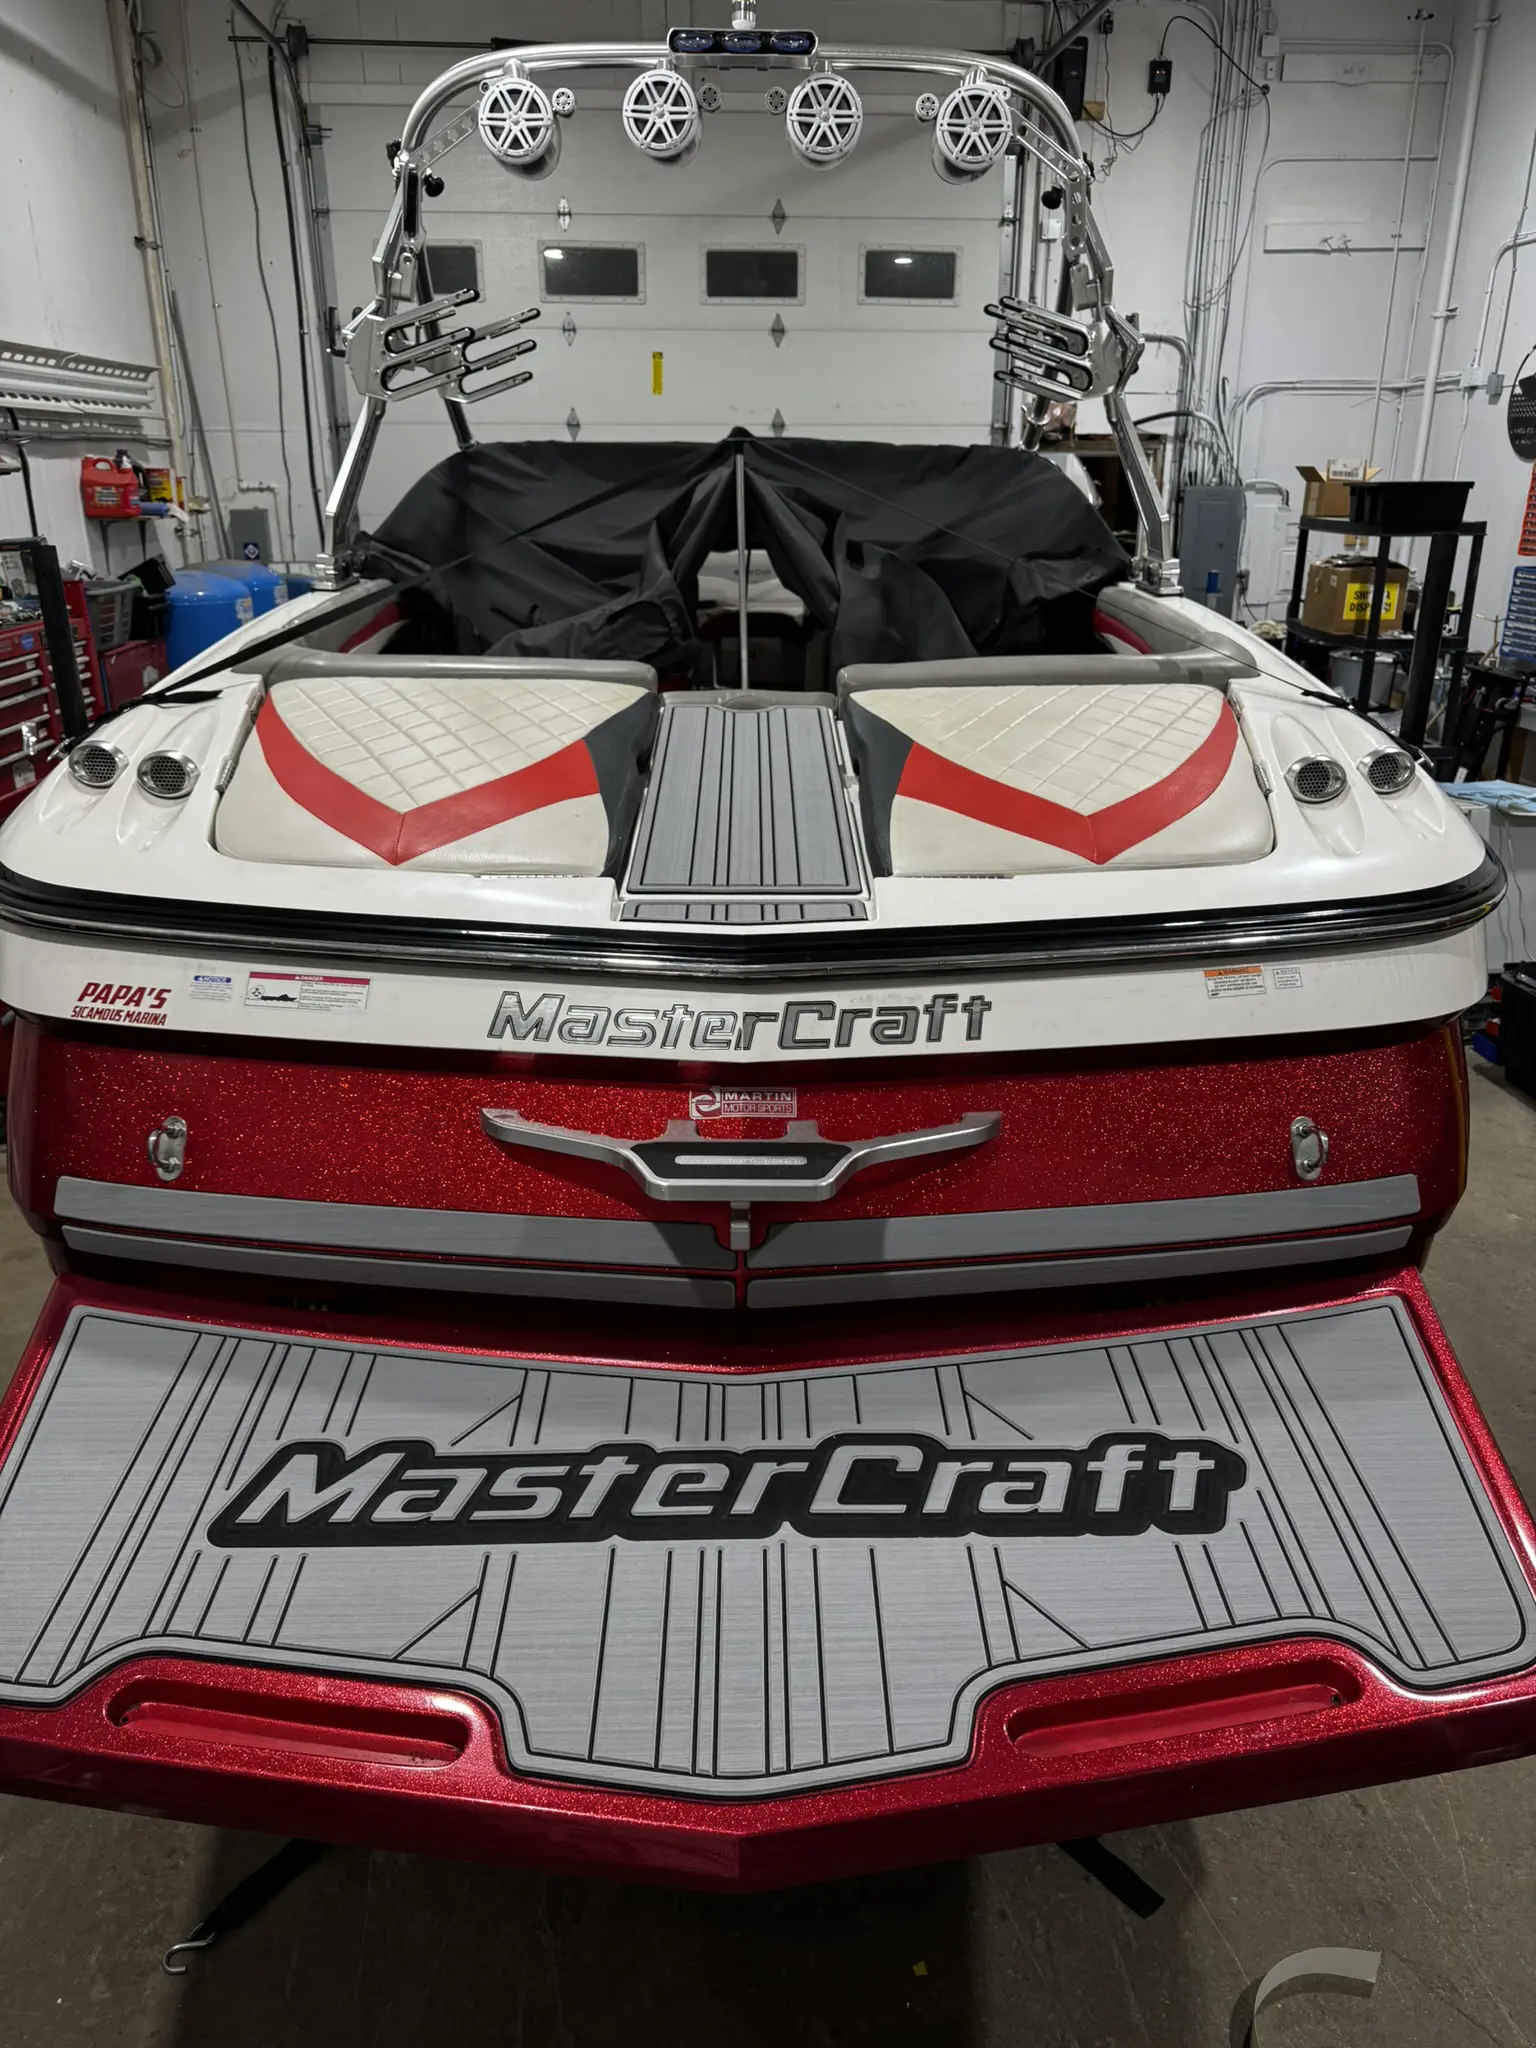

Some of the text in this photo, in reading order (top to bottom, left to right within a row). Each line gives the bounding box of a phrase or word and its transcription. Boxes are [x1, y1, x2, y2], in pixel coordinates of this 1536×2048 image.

[77, 982, 172, 1009] PAPA'S
[71, 1005, 168, 1026] SICAMOUS MARINA
[487, 990, 993, 1051] MasterCraft
[724, 1103, 792, 1113] MOTOR SPORTS
[725, 1092, 792, 1101] MARTIN
[233, 1442, 1218, 1525] MasterCraft
